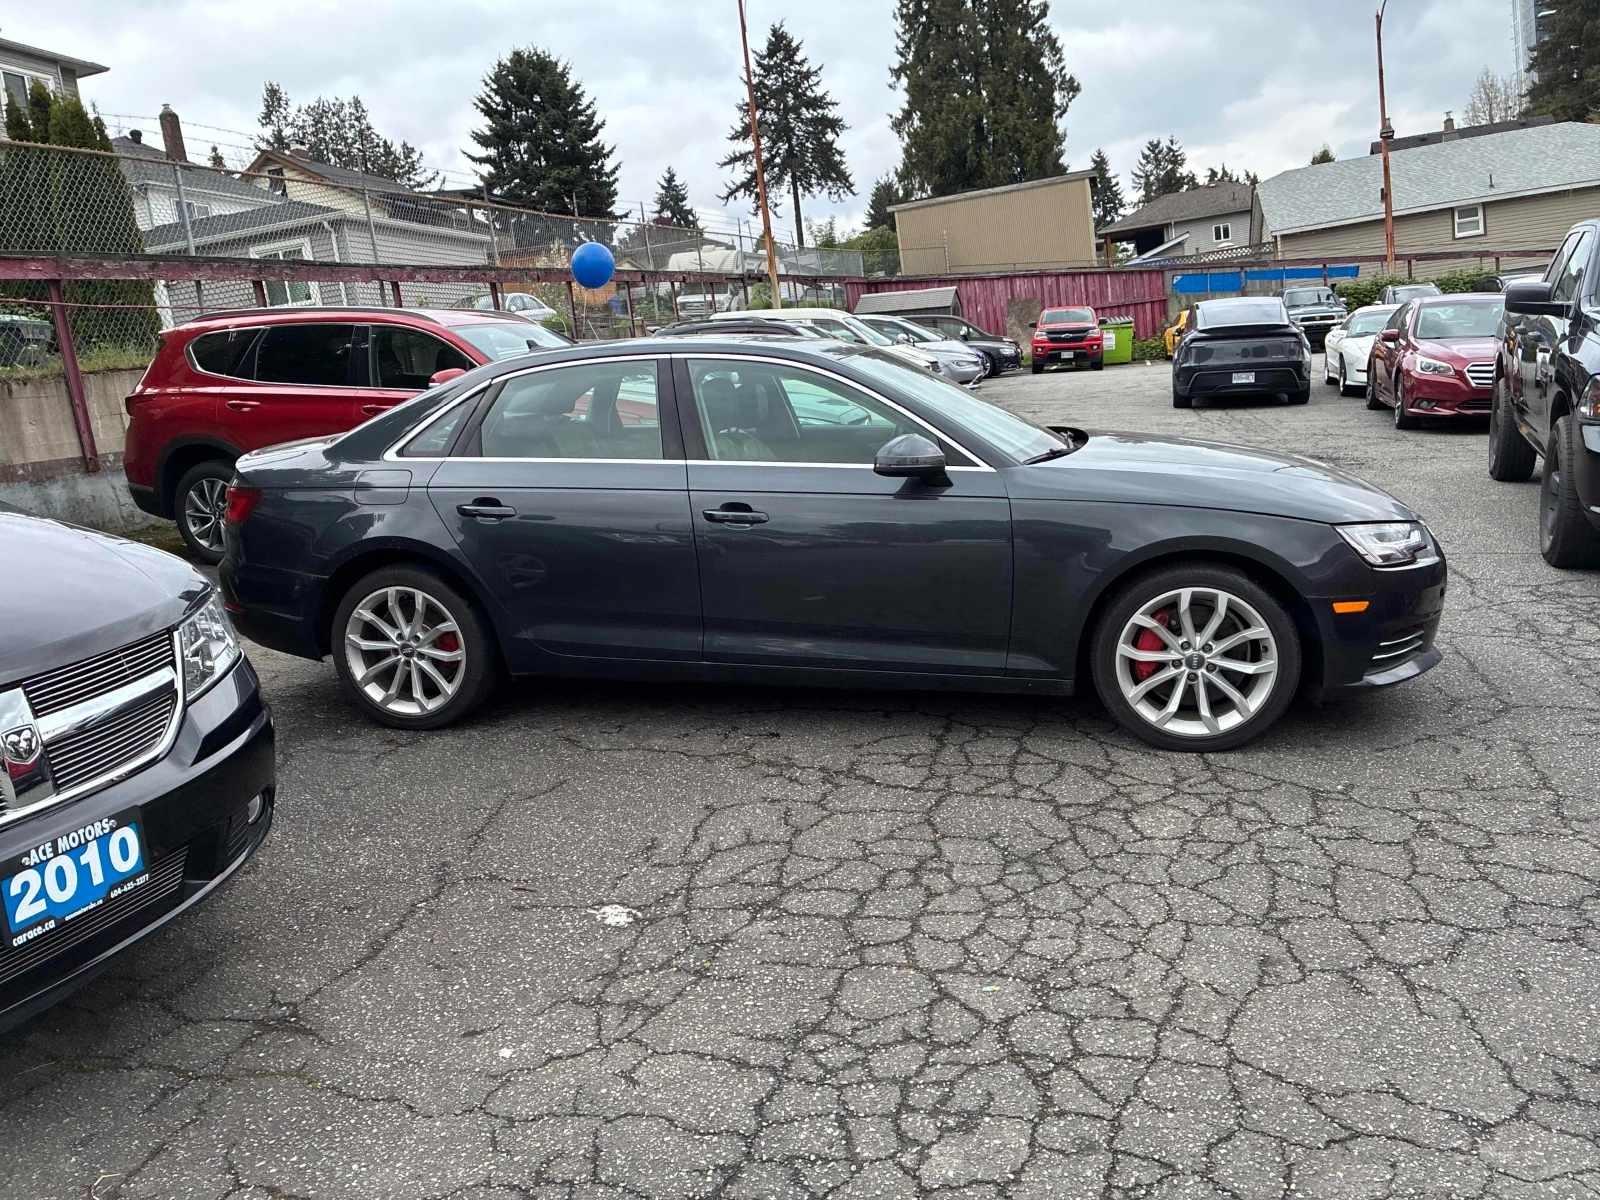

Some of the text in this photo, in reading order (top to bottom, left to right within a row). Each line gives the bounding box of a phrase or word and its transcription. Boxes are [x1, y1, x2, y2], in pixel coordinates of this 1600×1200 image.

[30, 818, 110, 866] ACE MOTORS
[10, 826, 139, 923] 2010
[12, 919, 55, 946] carace.ca
